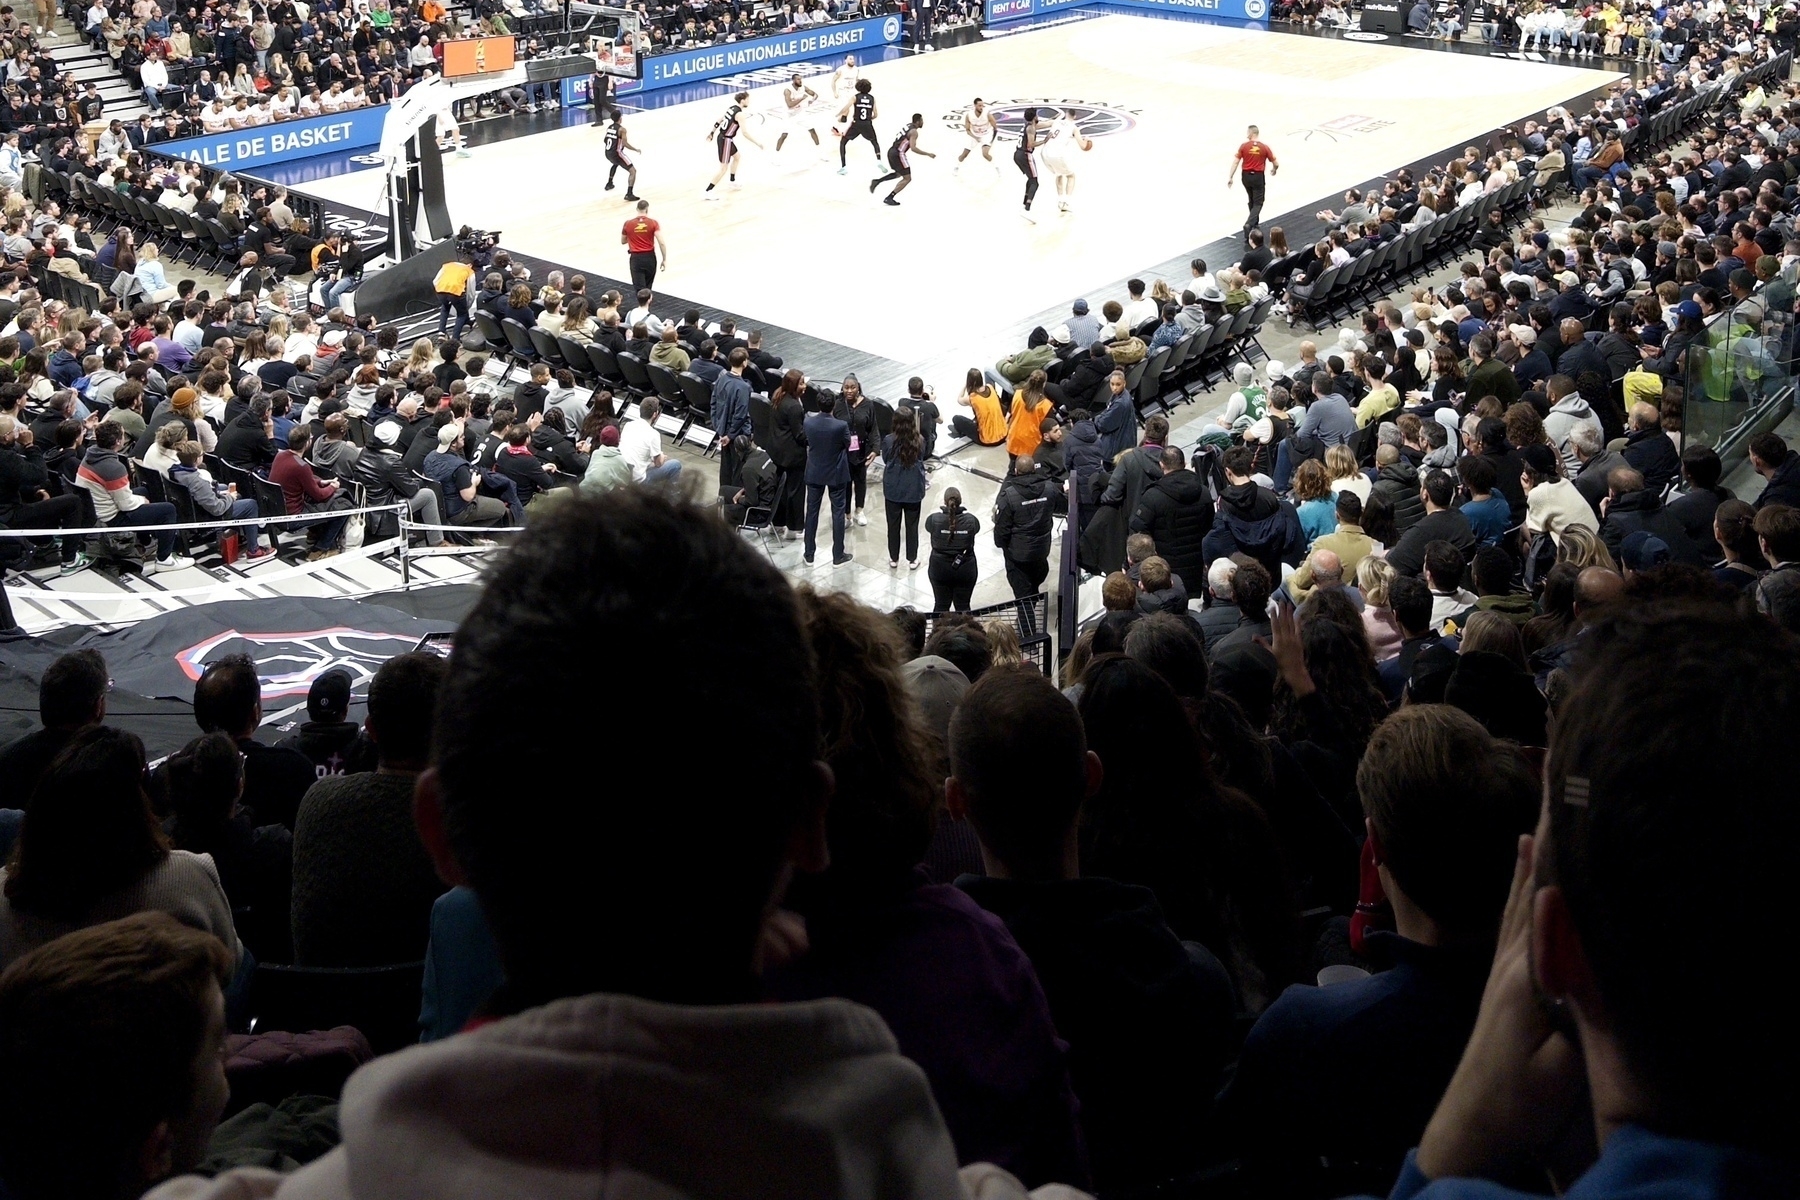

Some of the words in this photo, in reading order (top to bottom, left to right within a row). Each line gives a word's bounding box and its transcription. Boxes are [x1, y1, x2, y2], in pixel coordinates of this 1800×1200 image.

[992, 1, 1010, 15] RENT
[1016, 0, 1031, 11] CAR
[1365, 3, 1398, 12] nutribullet
[663, 60, 682, 79] LA
[685, 53, 724, 75] LIGUE
[735, 43, 797, 67] NATIONALE
[800, 36, 817, 53] DE
[819, 28, 865, 50] BASKET
[860, 108, 867, 120] 3
[236, 138, 264, 160] DE
[271, 121, 353, 151] BASKET
[471, 450, 482, 465] 2
